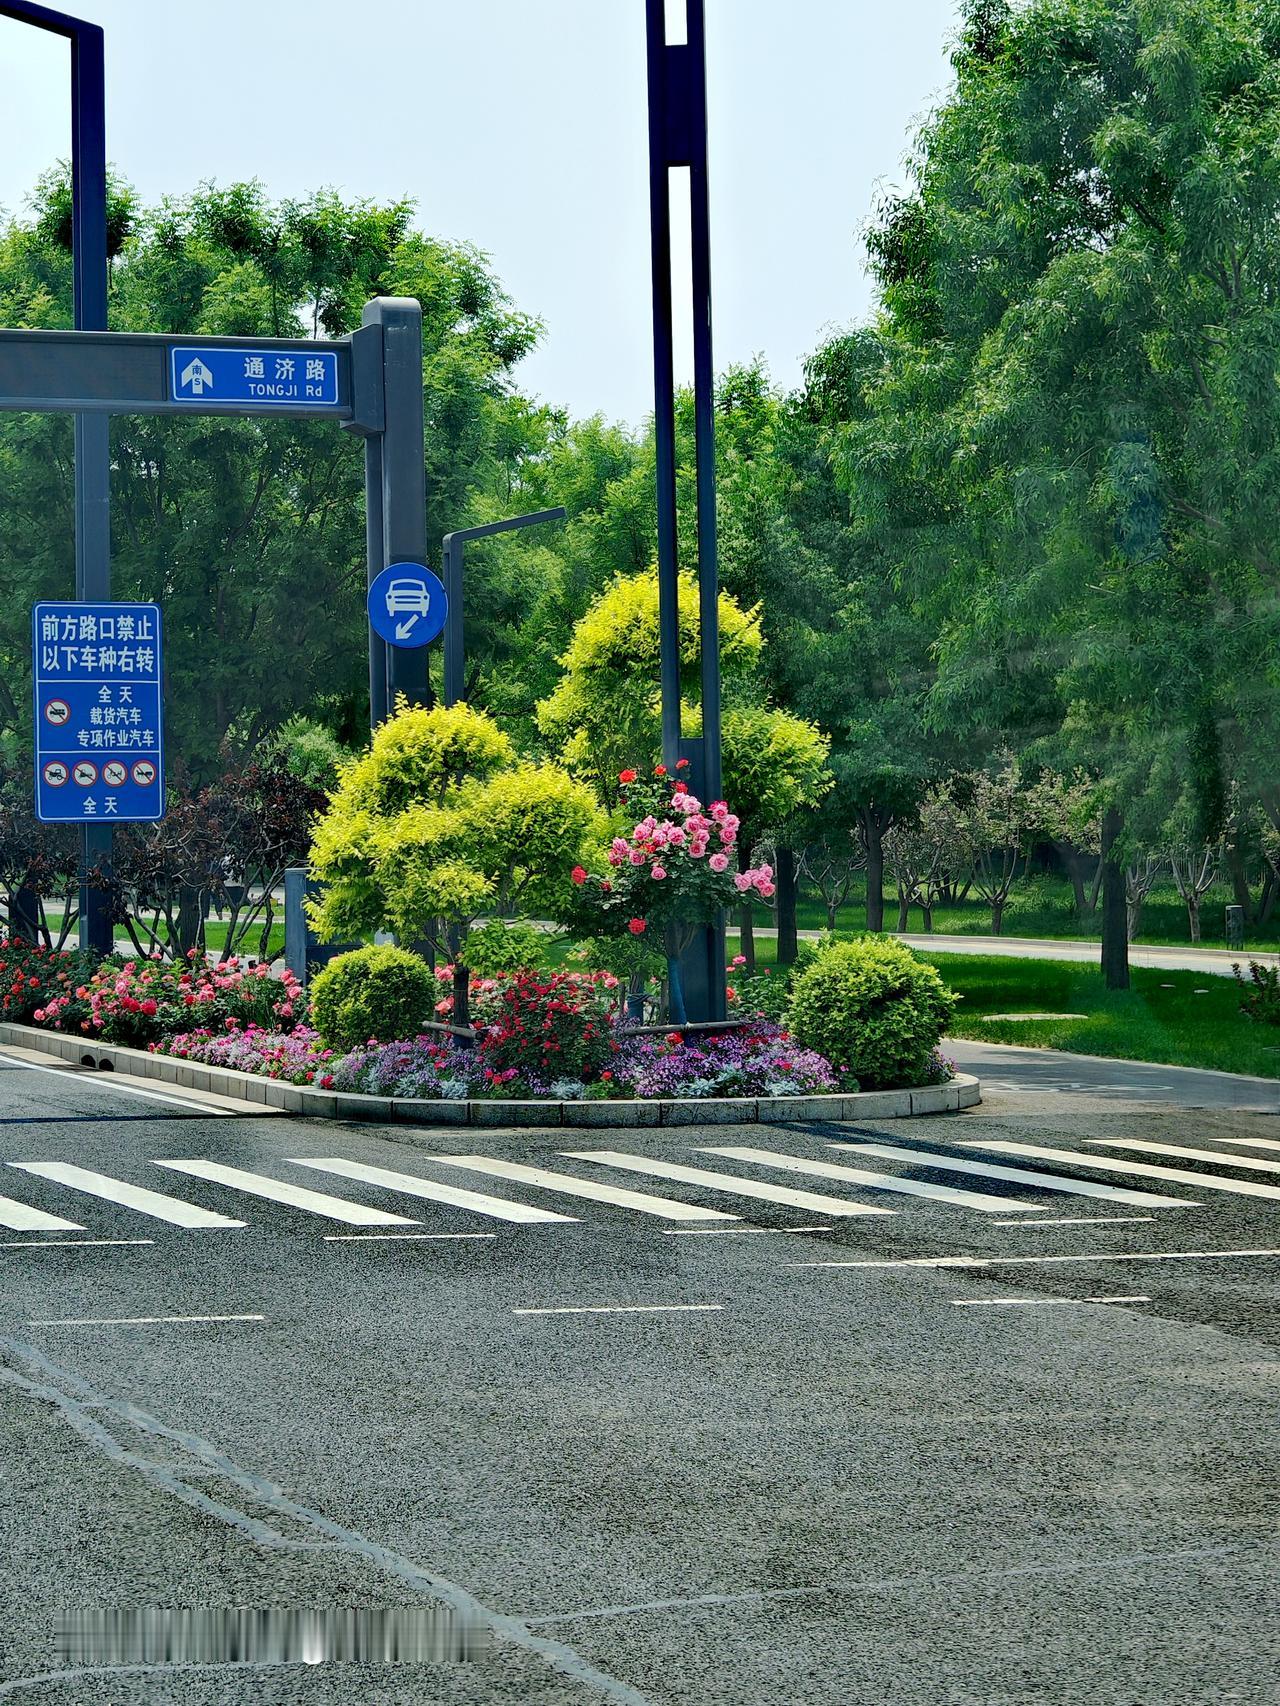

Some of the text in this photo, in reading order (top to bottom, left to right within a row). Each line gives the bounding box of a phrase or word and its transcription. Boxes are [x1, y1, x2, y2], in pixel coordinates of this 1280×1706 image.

[191, 364, 202, 376] 南
[244, 357, 326, 381] 通济路
[194, 378, 201, 386] S
[248, 383, 322, 397] TONGJI Rd
[41, 614, 154, 641] 前方路口禁止
[42, 645, 155, 673] 以下车种右转
[98, 685, 133, 703] 全天
[89, 707, 142, 725] 载货汽车
[77, 729, 155, 747] 专项作业汽车
[83, 796, 118, 814] 全天
